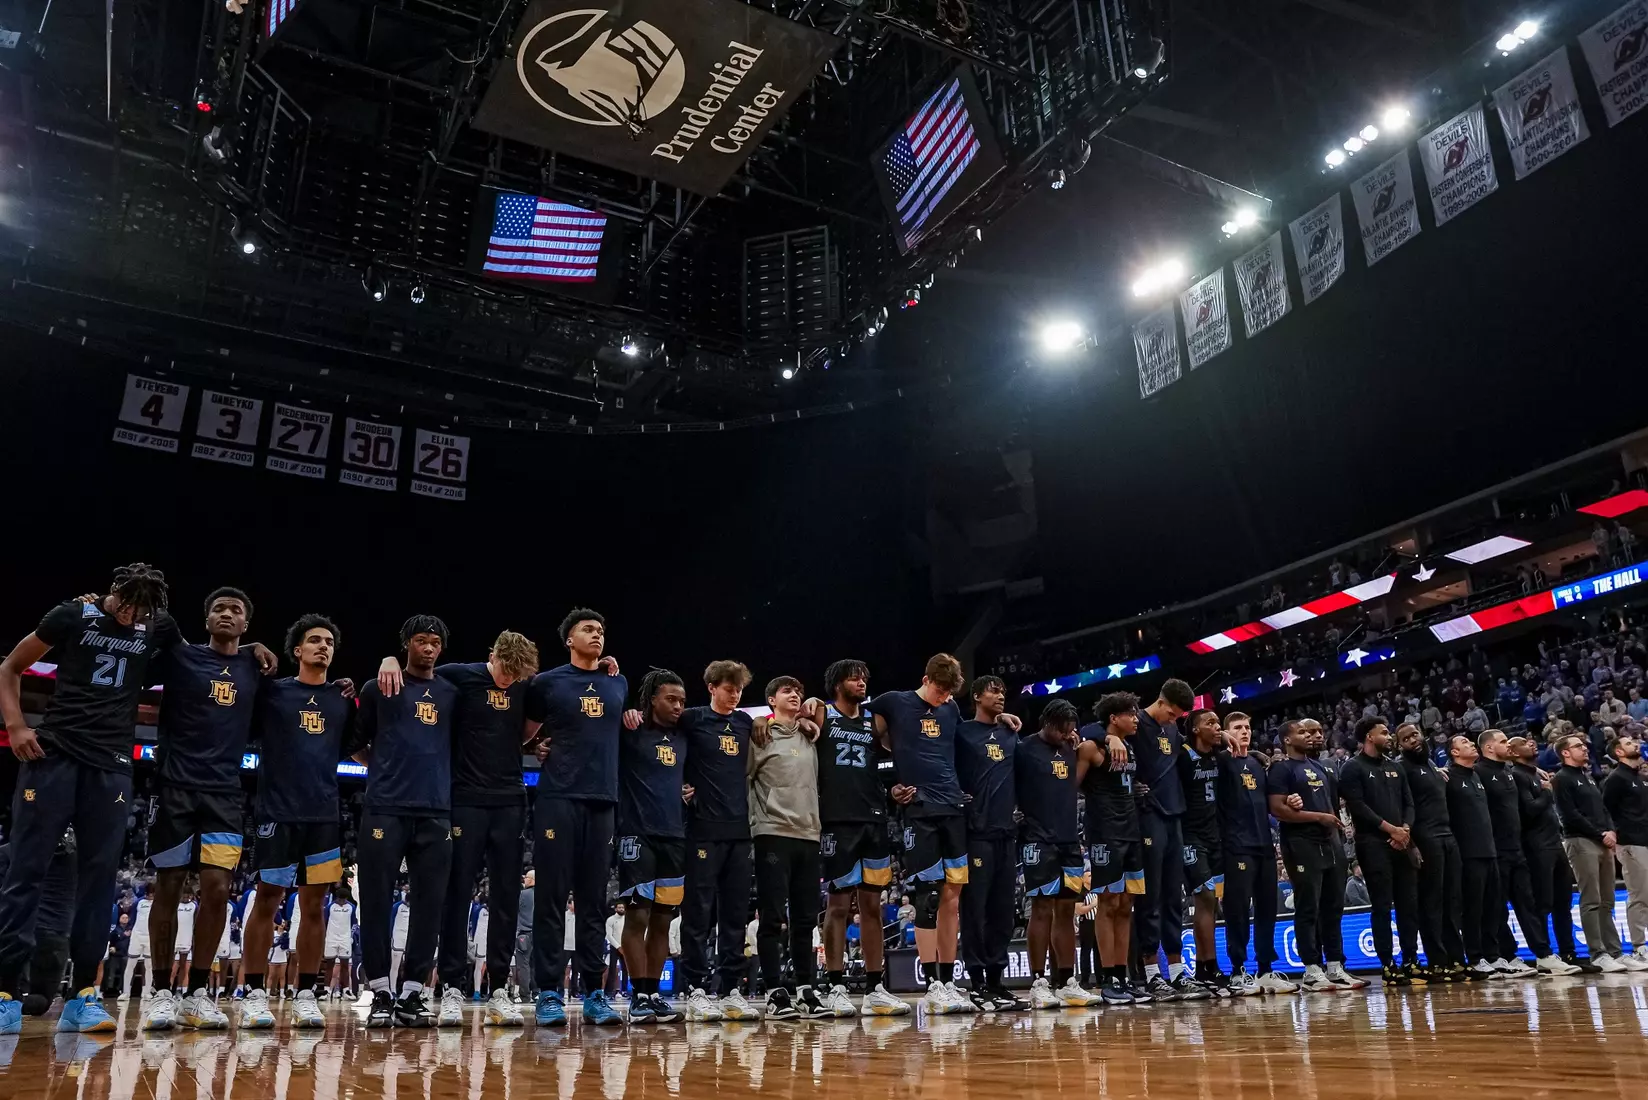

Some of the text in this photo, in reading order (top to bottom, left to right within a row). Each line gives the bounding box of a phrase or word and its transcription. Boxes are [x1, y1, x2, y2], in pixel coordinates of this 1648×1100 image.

[1603, 8, 1647, 43] DEVILS
[1513, 70, 1551, 101] DEVILS
[651, 41, 764, 164] Prudential
[710, 81, 785, 154] Center
[1435, 124, 1468, 151] DEVILS
[1525, 122, 1569, 157] CHAMPIONS
[1524, 132, 1577, 171] 2000-2001
[1366, 169, 1396, 194] DEVILS
[1432, 174, 1455, 198] EASTERN
[1441, 170, 1487, 207] CHAMPIONS
[1443, 183, 1488, 218] 1999-2000
[1302, 212, 1330, 235] DEVILS
[135, 378, 180, 396] STEVENS
[140, 394, 164, 426] 4
[216, 408, 242, 440] 3
[277, 417, 324, 454] 27
[355, 421, 393, 436] BRODEUR
[151, 438, 176, 449] 2005
[348, 431, 395, 468] 30
[431, 434, 455, 447] ELIAS
[300, 465, 322, 475] 2004
[419, 443, 463, 478] 26
[374, 479, 395, 487] 2014
[1592, 568, 1641, 595] THE HALL
[79, 629, 147, 655] Marquette
[90, 653, 128, 688] 21
[991, 663, 1027, 675] 1982
[209, 680, 237, 707] MU
[487, 689, 511, 711] MU
[414, 701, 439, 725] MU
[579, 696, 604, 718] MU
[299, 710, 326, 734] MU
[920, 718, 941, 738] MU
[719, 735, 740, 756] MU
[828, 726, 874, 744] Marquette
[1157, 736, 1173, 756] MU
[656, 745, 677, 767] MU
[835, 742, 867, 768] 23
[985, 743, 1005, 762] MU
[1051, 760, 1069, 780] MU
[1241, 773, 1257, 790] MU
[1120, 772, 1132, 794] 4
[1204, 781, 1216, 802] 5
[620, 836, 642, 862] MU
[1023, 842, 1041, 866] MU
[1091, 843, 1110, 867] MU
